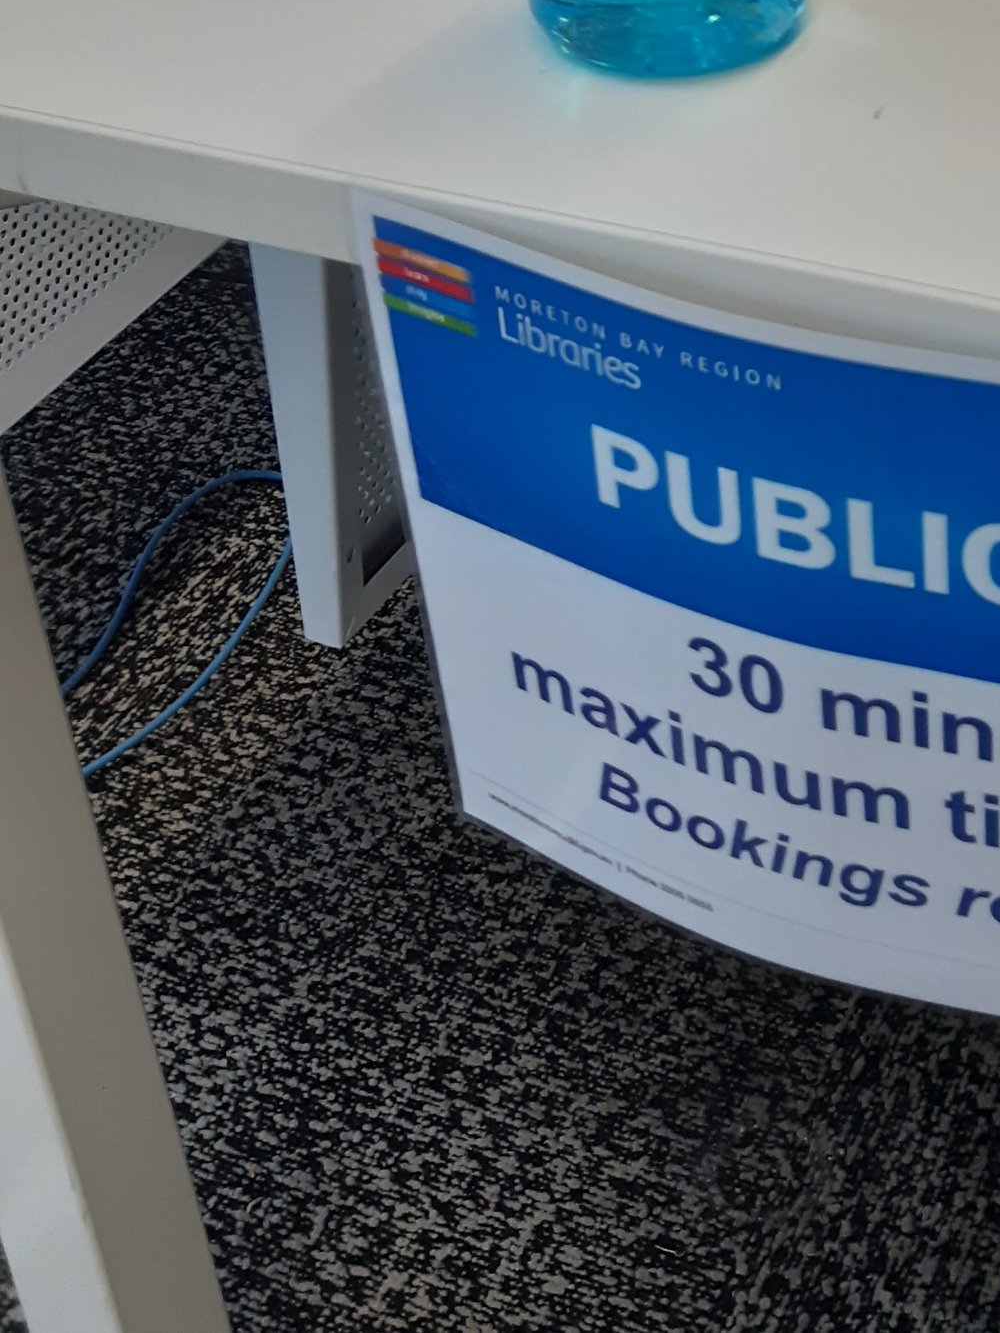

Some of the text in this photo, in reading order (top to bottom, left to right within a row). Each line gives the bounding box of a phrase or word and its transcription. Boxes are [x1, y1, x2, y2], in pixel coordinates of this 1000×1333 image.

[494, 285, 606, 341] MORETON
[619, 331, 665, 358] BAY
[679, 351, 782, 391] REGION
[498, 306, 642, 390] Libraries
[687, 636, 785, 715] 30
[510, 650, 911, 830] maximum
[599, 761, 931, 908] Bookings
